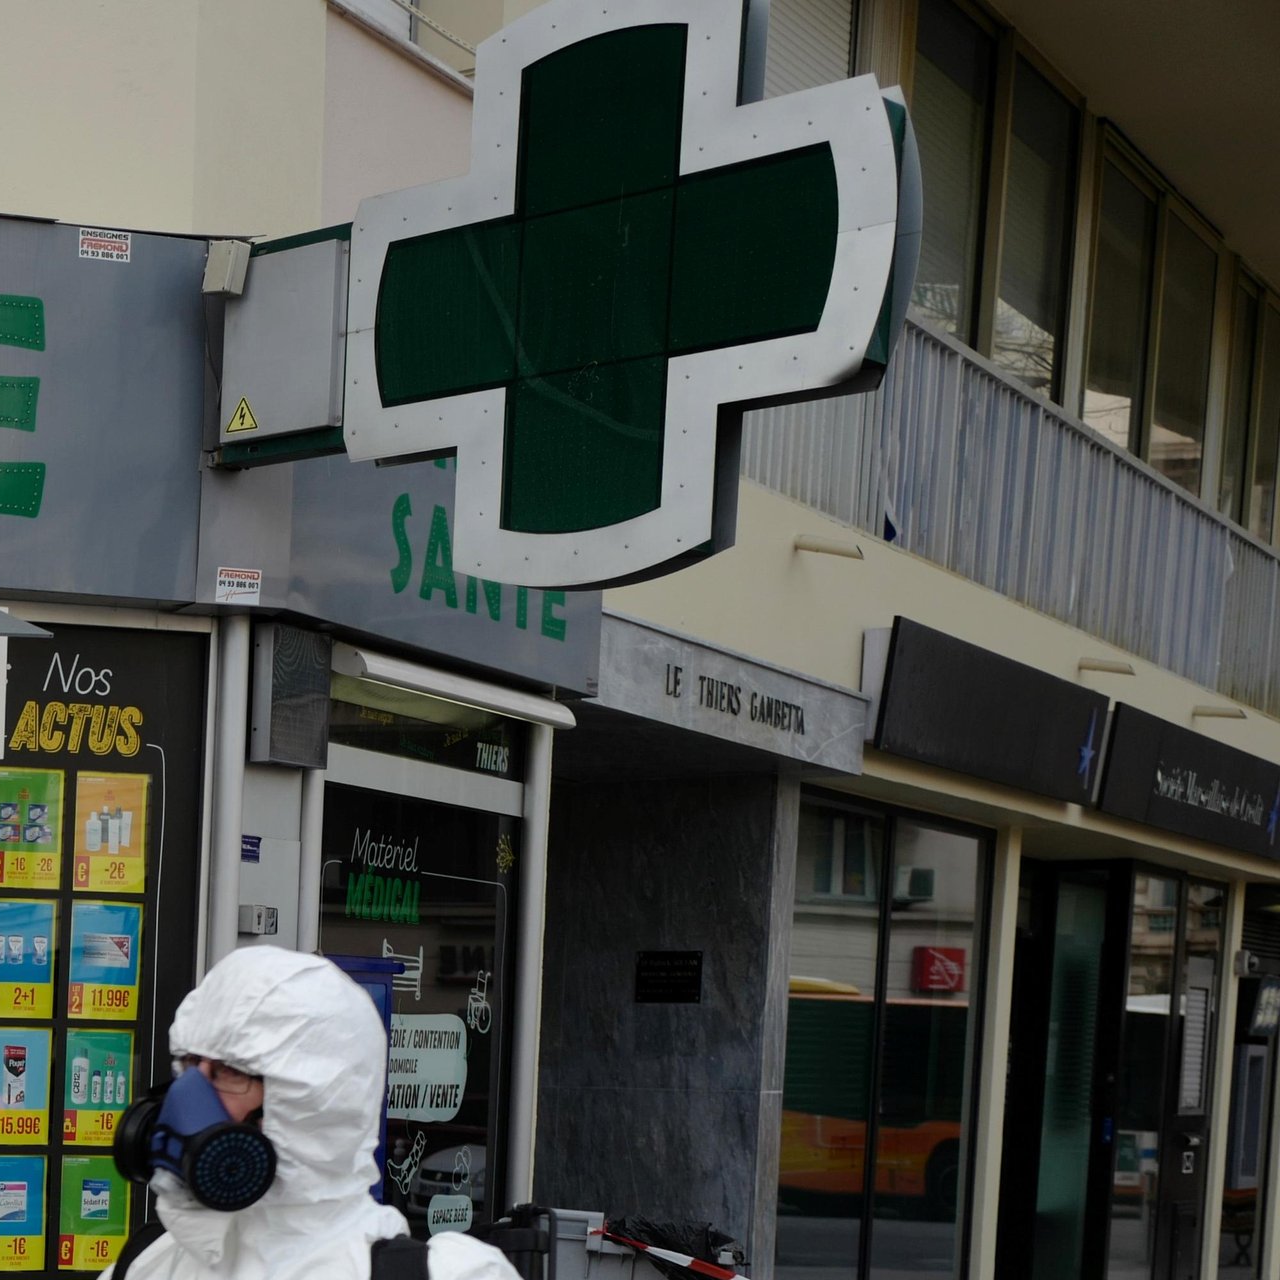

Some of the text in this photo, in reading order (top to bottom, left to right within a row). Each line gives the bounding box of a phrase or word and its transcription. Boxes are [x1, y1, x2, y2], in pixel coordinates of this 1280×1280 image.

[81, 229, 129, 240] ENSEIGNES
[42, 651, 114, 697] Nos
[665, 663, 805, 735] LE THIERS GAMBETTA
[8, 700, 144, 758] ACTUS
[476, 742, 509, 773] THIERS
[351, 826, 420, 874] Matériel
[104, 862, 125, 880] -2€
[345, 864, 422, 925] MÉDICAL
[13, 986, 35, 1007] 2+1
[91, 988, 130, 1009] 11.99€
[413, 1029, 461, 1049] CONTENTION
[429, 1084, 460, 1109] VENTE
[0, 1116, 41, 1136] 15.99€
[94, 1112, 114, 1131] -1€
[432, 1208, 453, 1225] ESPACE
[7, 1237, 26, 1256] -1€
[90, 1240, 109, 1258] -1€
